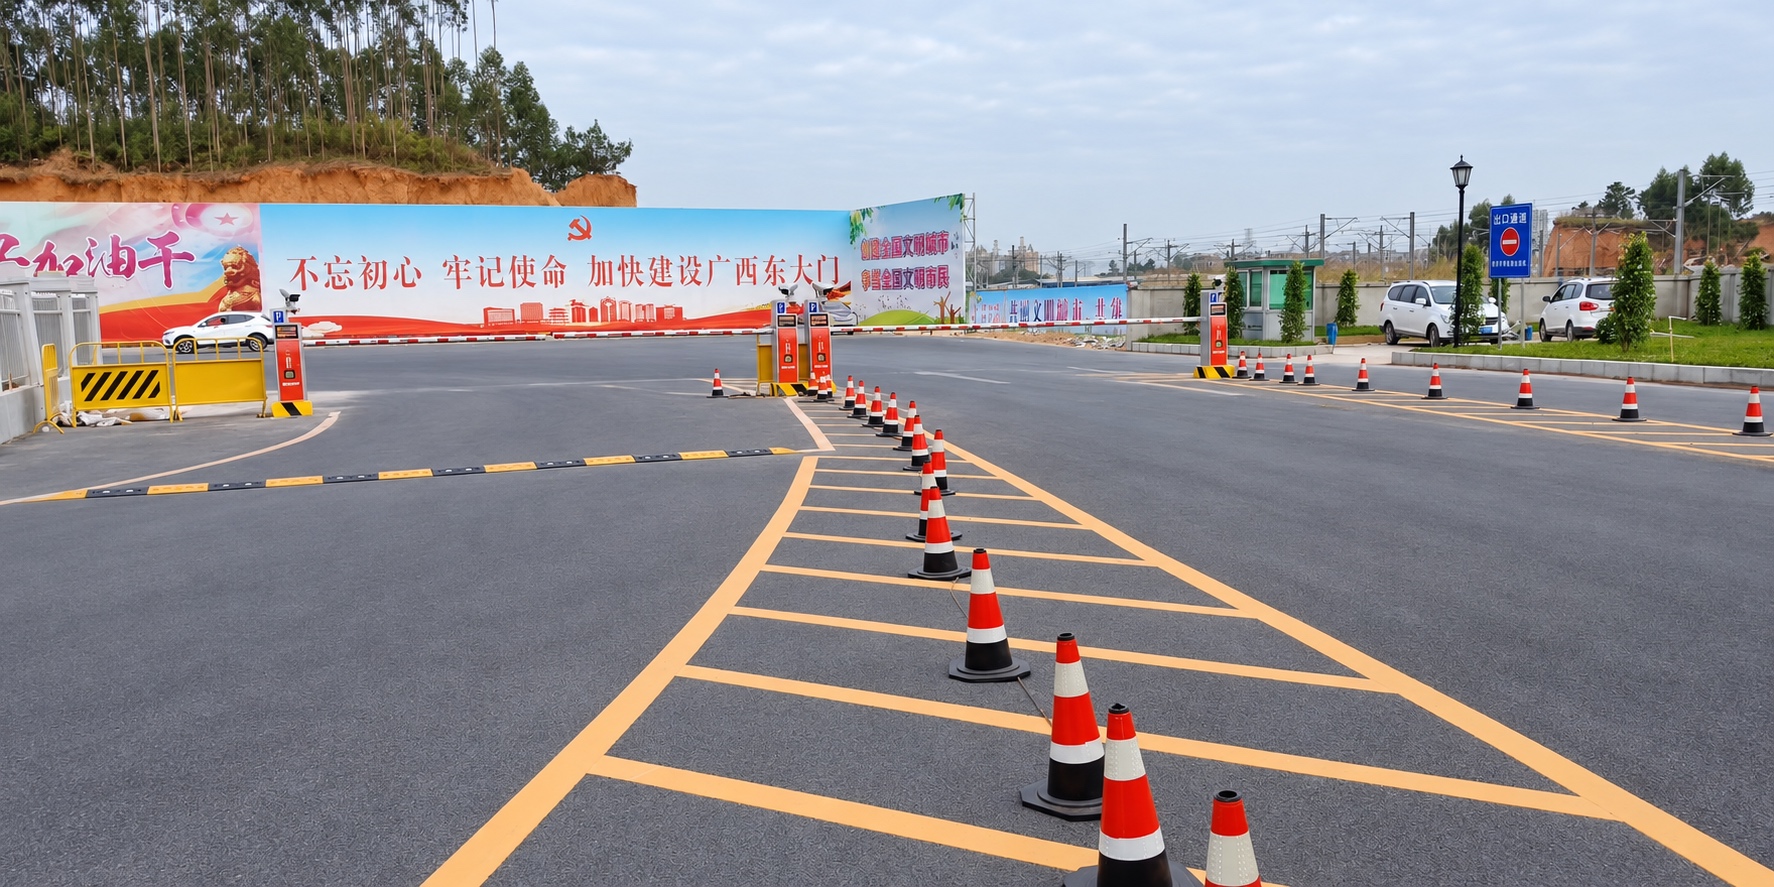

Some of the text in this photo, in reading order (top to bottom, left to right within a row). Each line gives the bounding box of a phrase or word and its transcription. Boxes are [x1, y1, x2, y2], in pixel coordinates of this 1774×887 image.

[287, 254, 839, 291] 不忘初心 牢记使命 加快建设广西东大门
